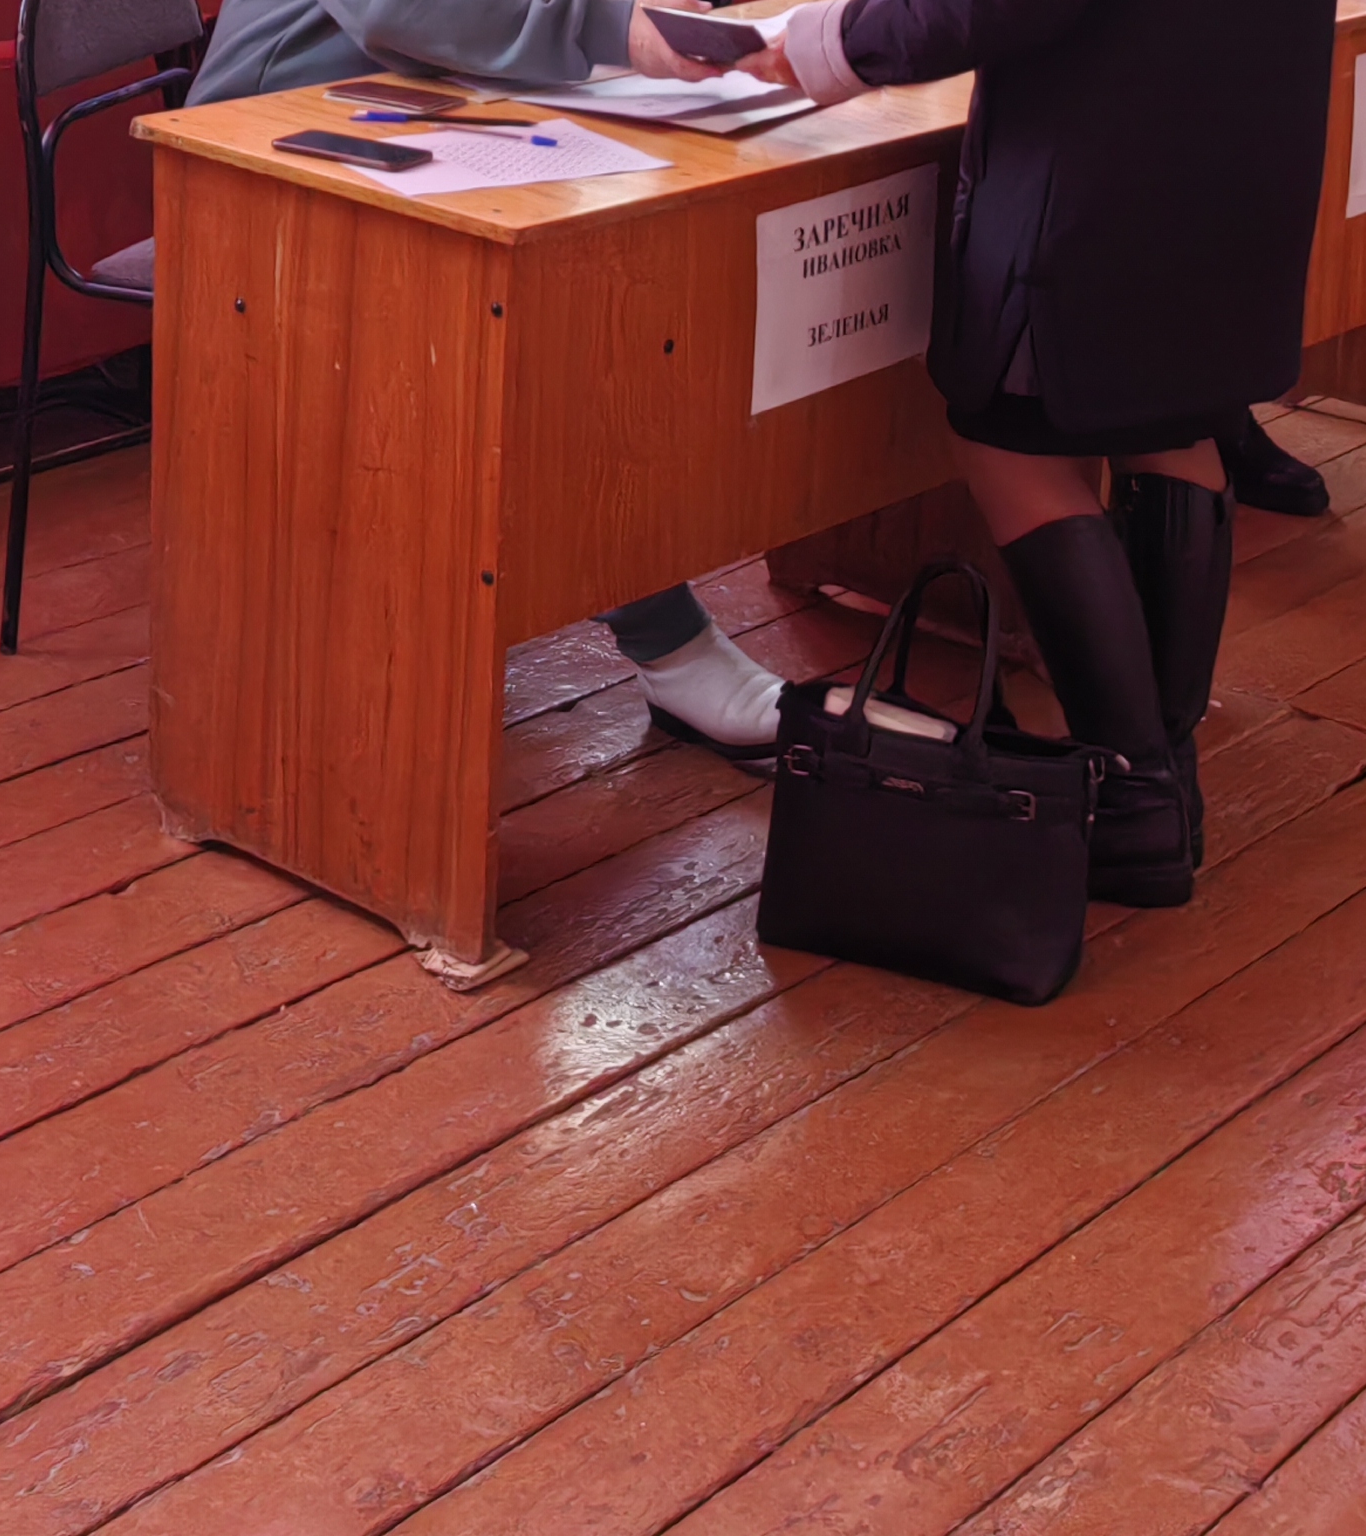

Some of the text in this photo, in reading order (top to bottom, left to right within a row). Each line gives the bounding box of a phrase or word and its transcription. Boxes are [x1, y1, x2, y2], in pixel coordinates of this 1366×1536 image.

[793, 194, 910, 252] ЗАРЕЧНАЯ
[802, 233, 902, 279] ИВАНОВКА
[808, 304, 889, 347] ЗЕЛЕНАЯ
